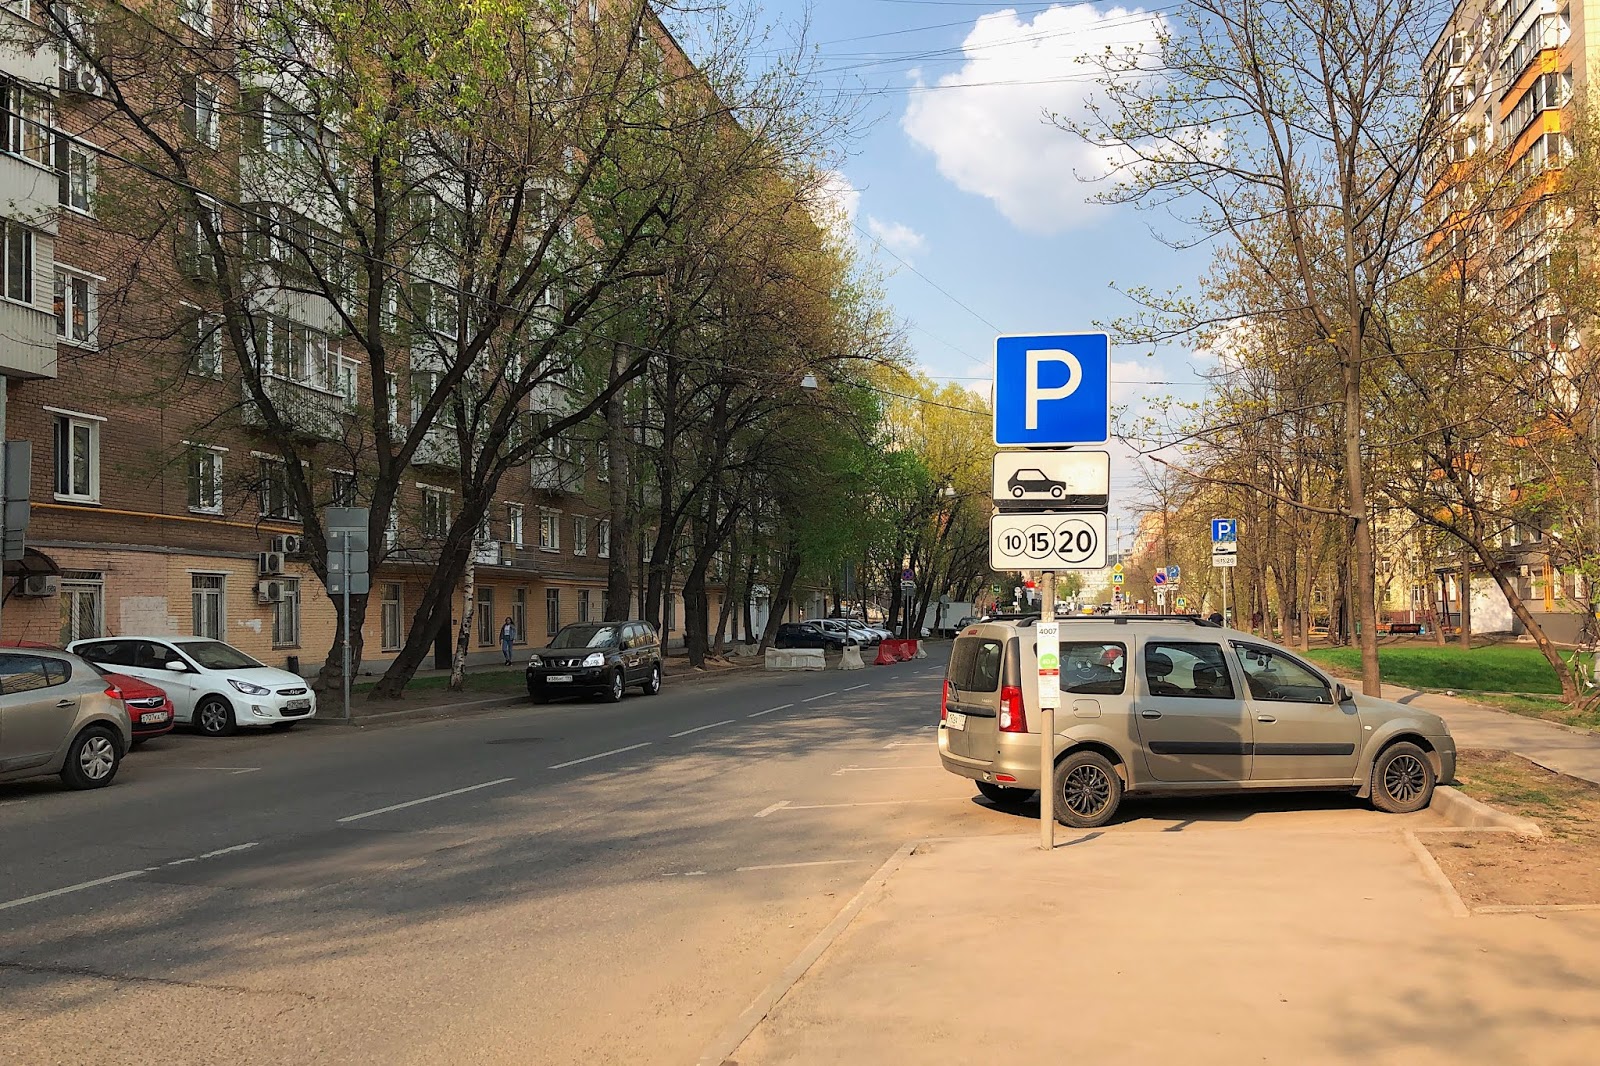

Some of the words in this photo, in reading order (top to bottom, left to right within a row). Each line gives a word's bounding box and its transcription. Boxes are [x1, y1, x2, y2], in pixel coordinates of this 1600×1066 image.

[1025, 349, 1082, 429] P
[1005, 535, 1021, 550] 10
[1029, 533, 1049, 551] 15
[1059, 530, 1091, 553] 20
[1218, 522, 1230, 540] P
